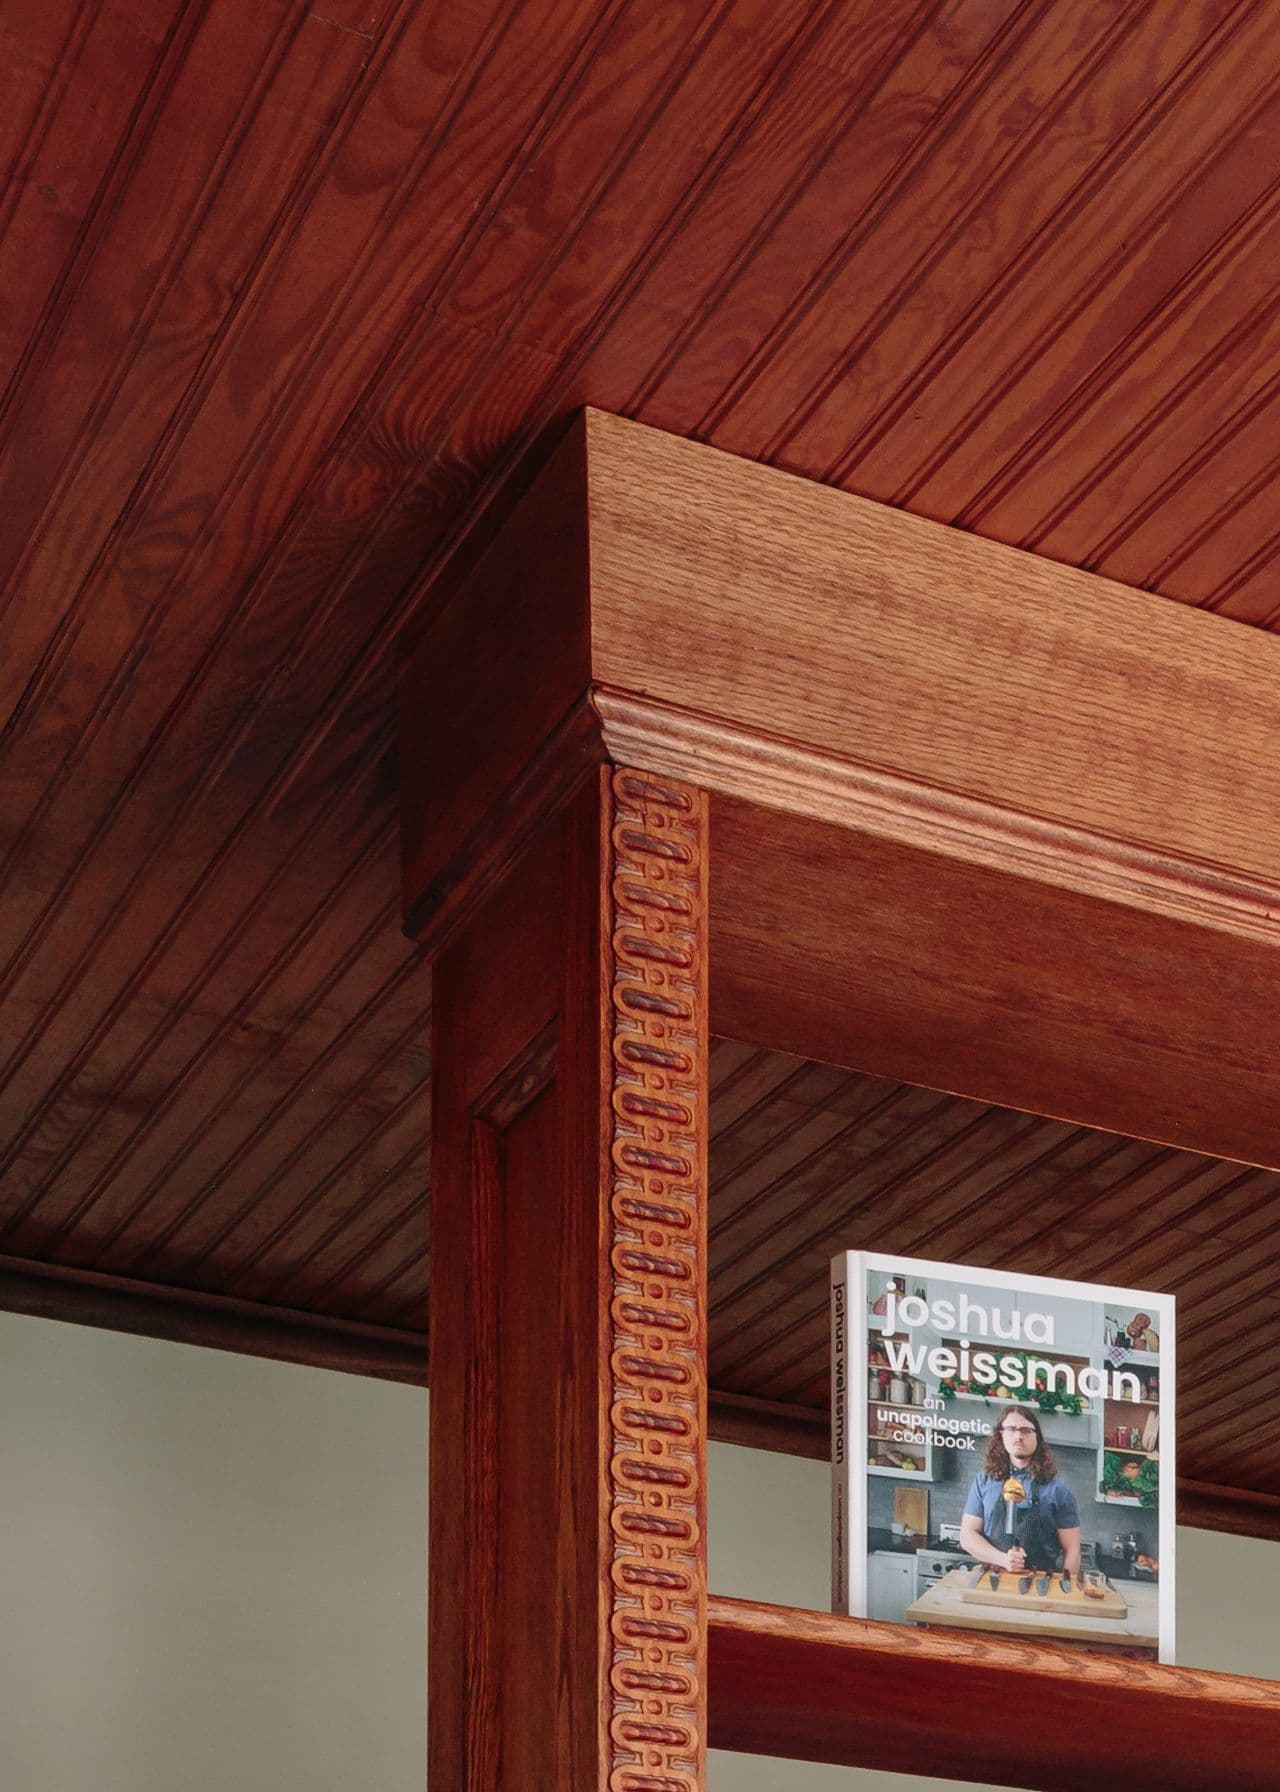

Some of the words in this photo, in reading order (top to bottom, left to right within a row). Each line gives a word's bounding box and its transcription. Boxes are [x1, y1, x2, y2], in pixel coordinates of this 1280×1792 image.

[833, 1284, 845, 1353] joshua
[883, 1282, 1054, 1345] joshua
[883, 1340, 1140, 1403] weissman
[836, 1359, 845, 1464] weissman
[877, 1408, 991, 1436] unapologetic
[924, 1397, 945, 1411] an
[893, 1429, 975, 1451] cookbook
